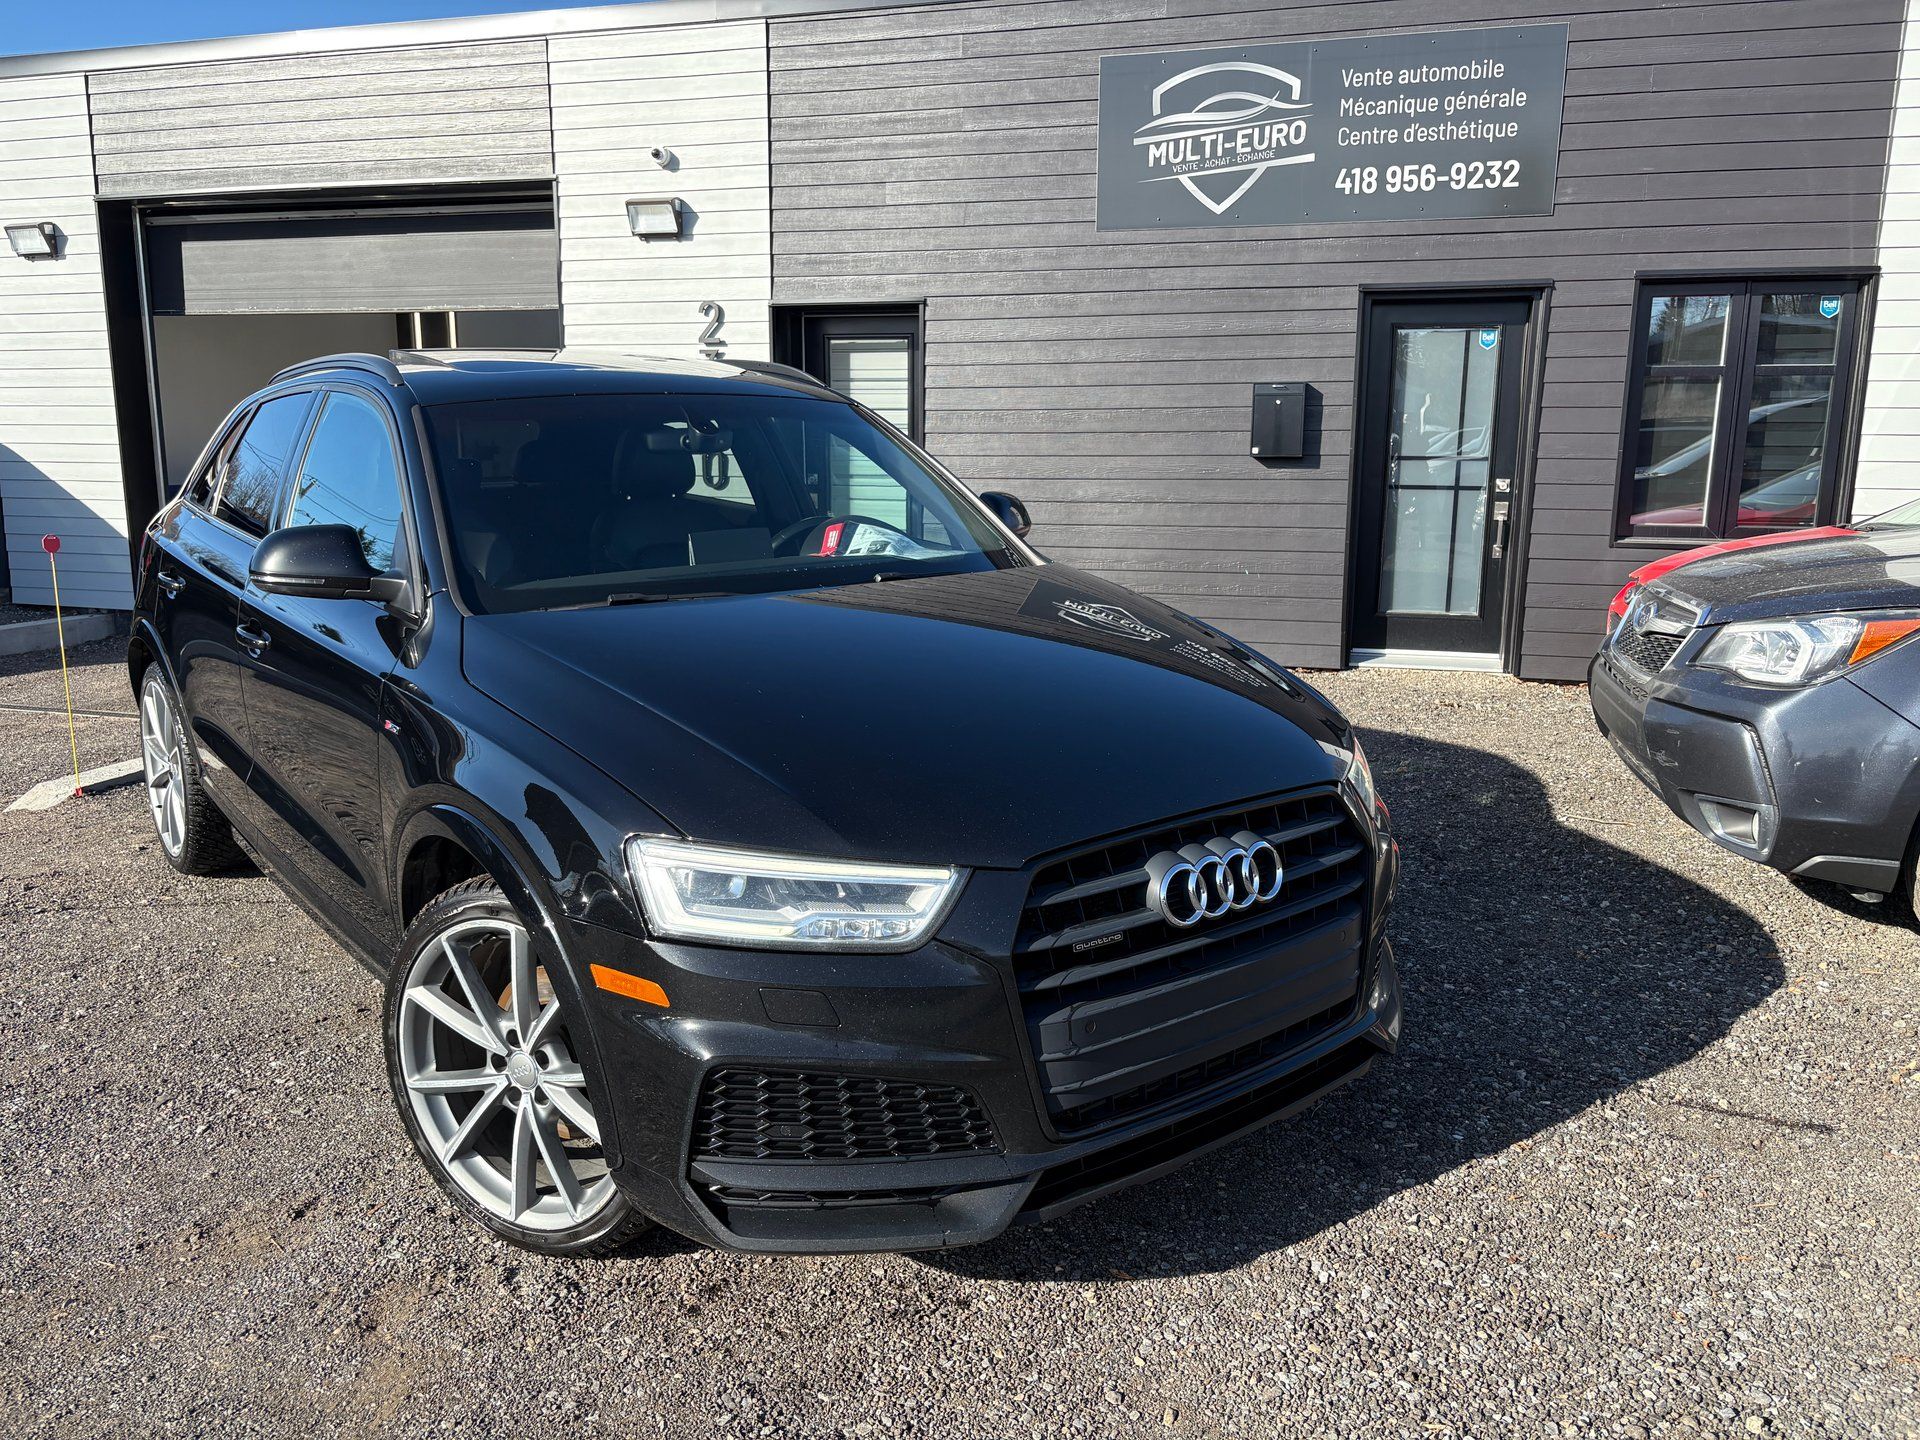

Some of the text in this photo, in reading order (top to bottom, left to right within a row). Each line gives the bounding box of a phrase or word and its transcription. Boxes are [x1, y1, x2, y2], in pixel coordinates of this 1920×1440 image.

[1341, 59, 1505, 88] Vente automobile
[1339, 87, 1527, 118] Mécanique générale
[1148, 120, 1307, 167] MULTI-EURO
[1337, 119, 1518, 146] Centre d'esthétique
[1172, 161, 1199, 173] VENTE
[1204, 156, 1230, 169] ACHAT
[1335, 159, 1521, 195] 418 956-9232
[1823, 300, 1838, 308] Bell
[1075, 933, 1122, 950] quattro
